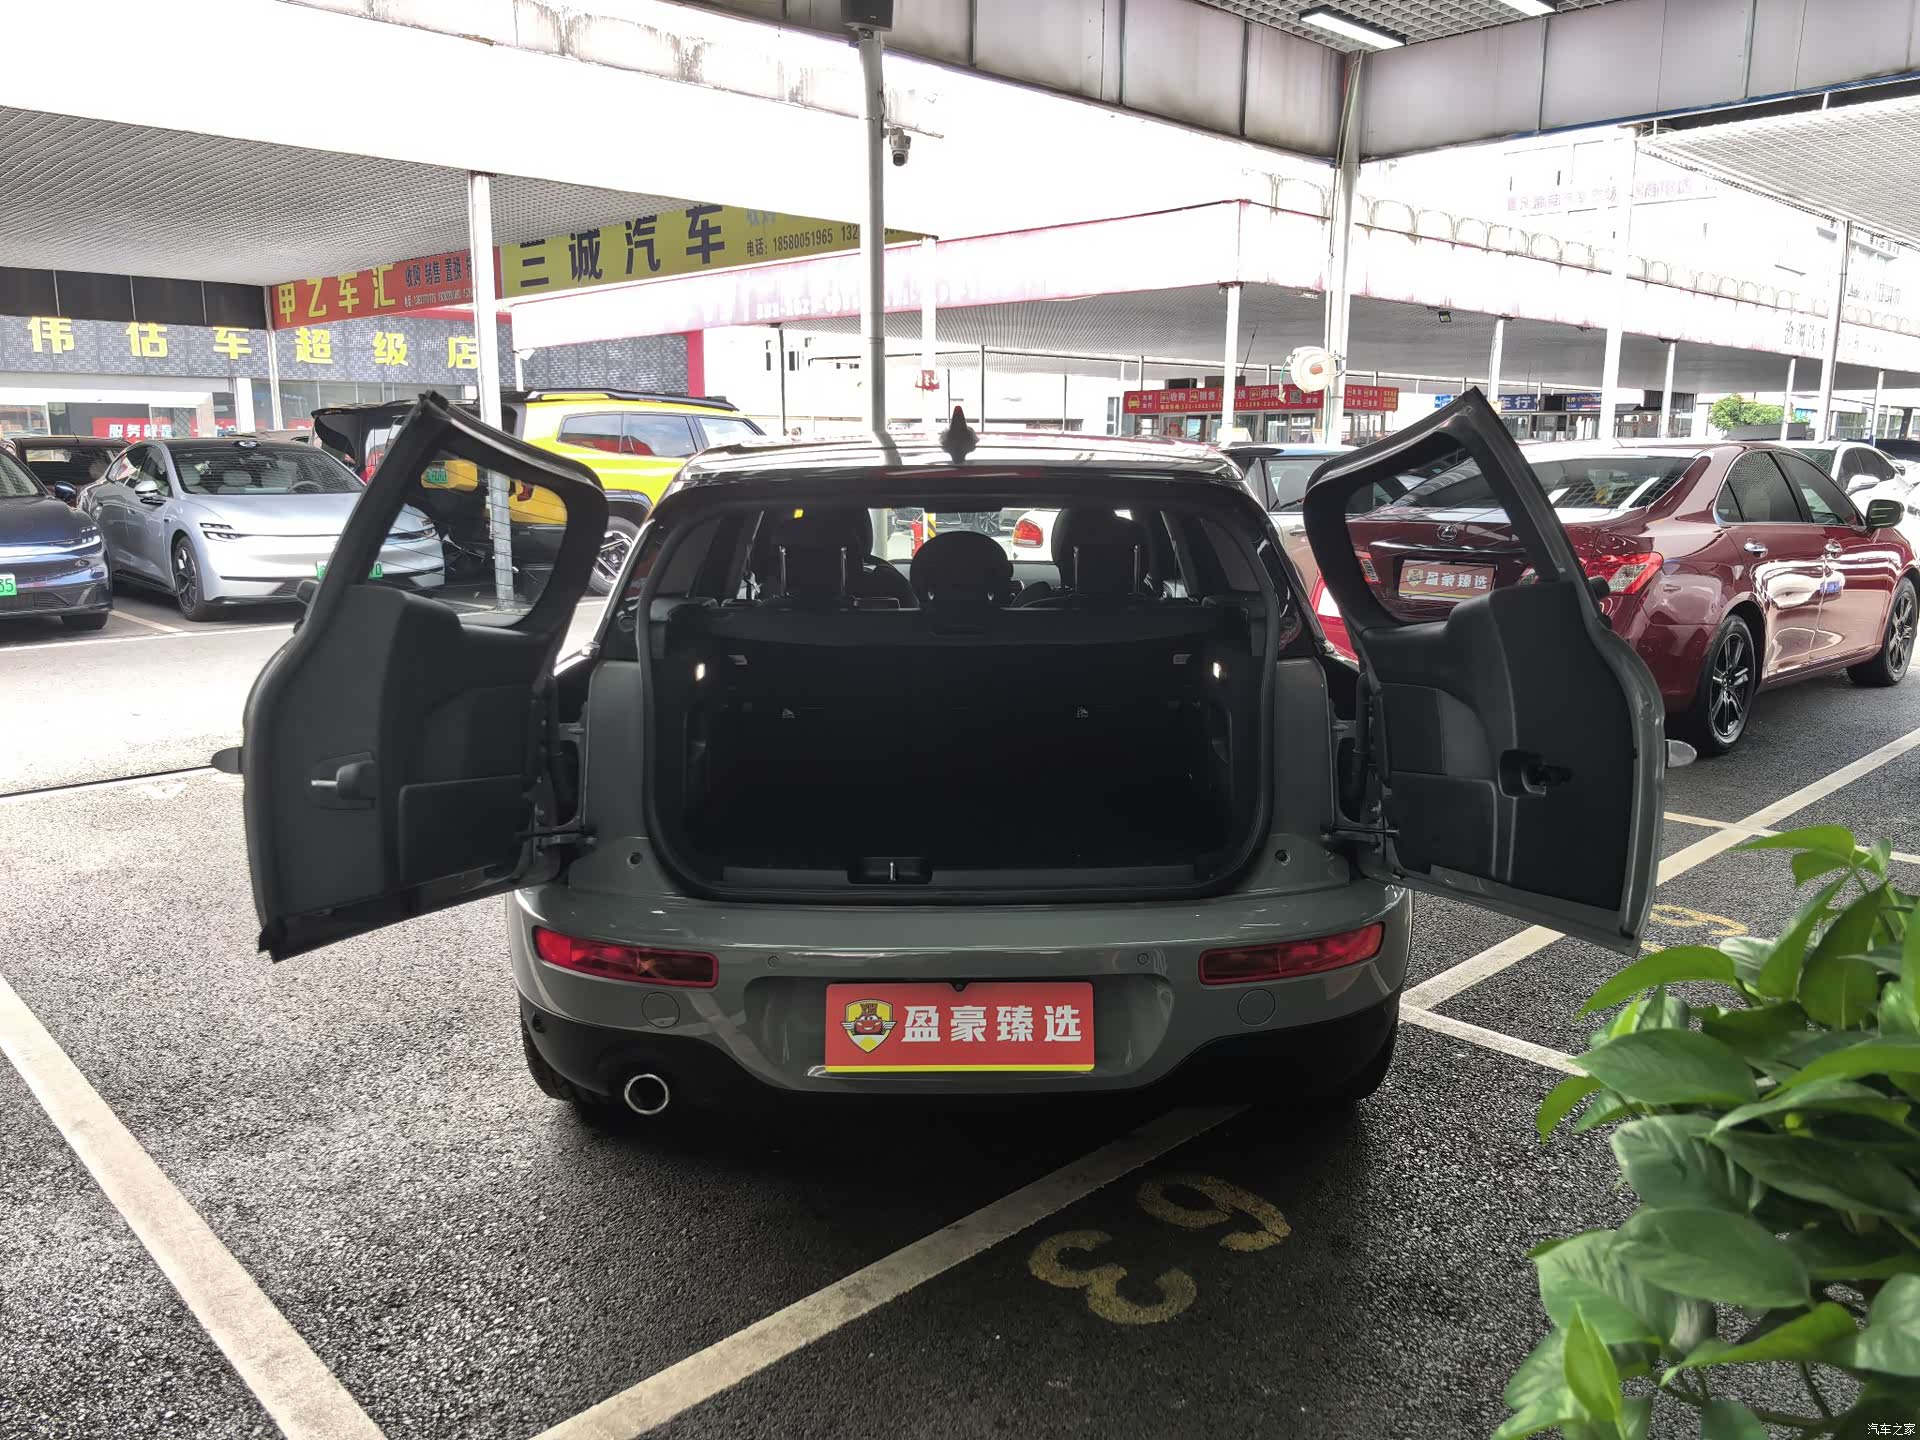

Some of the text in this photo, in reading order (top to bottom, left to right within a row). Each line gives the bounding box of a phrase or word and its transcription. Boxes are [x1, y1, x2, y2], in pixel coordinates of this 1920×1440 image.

[773, 228, 833, 253] 18580051965
[278, 263, 396, 323] 甲乙车汇
[1424, 571, 1488, 590] 盈豪臻选
[900, 1004, 1082, 1043] 盈豪臻选
